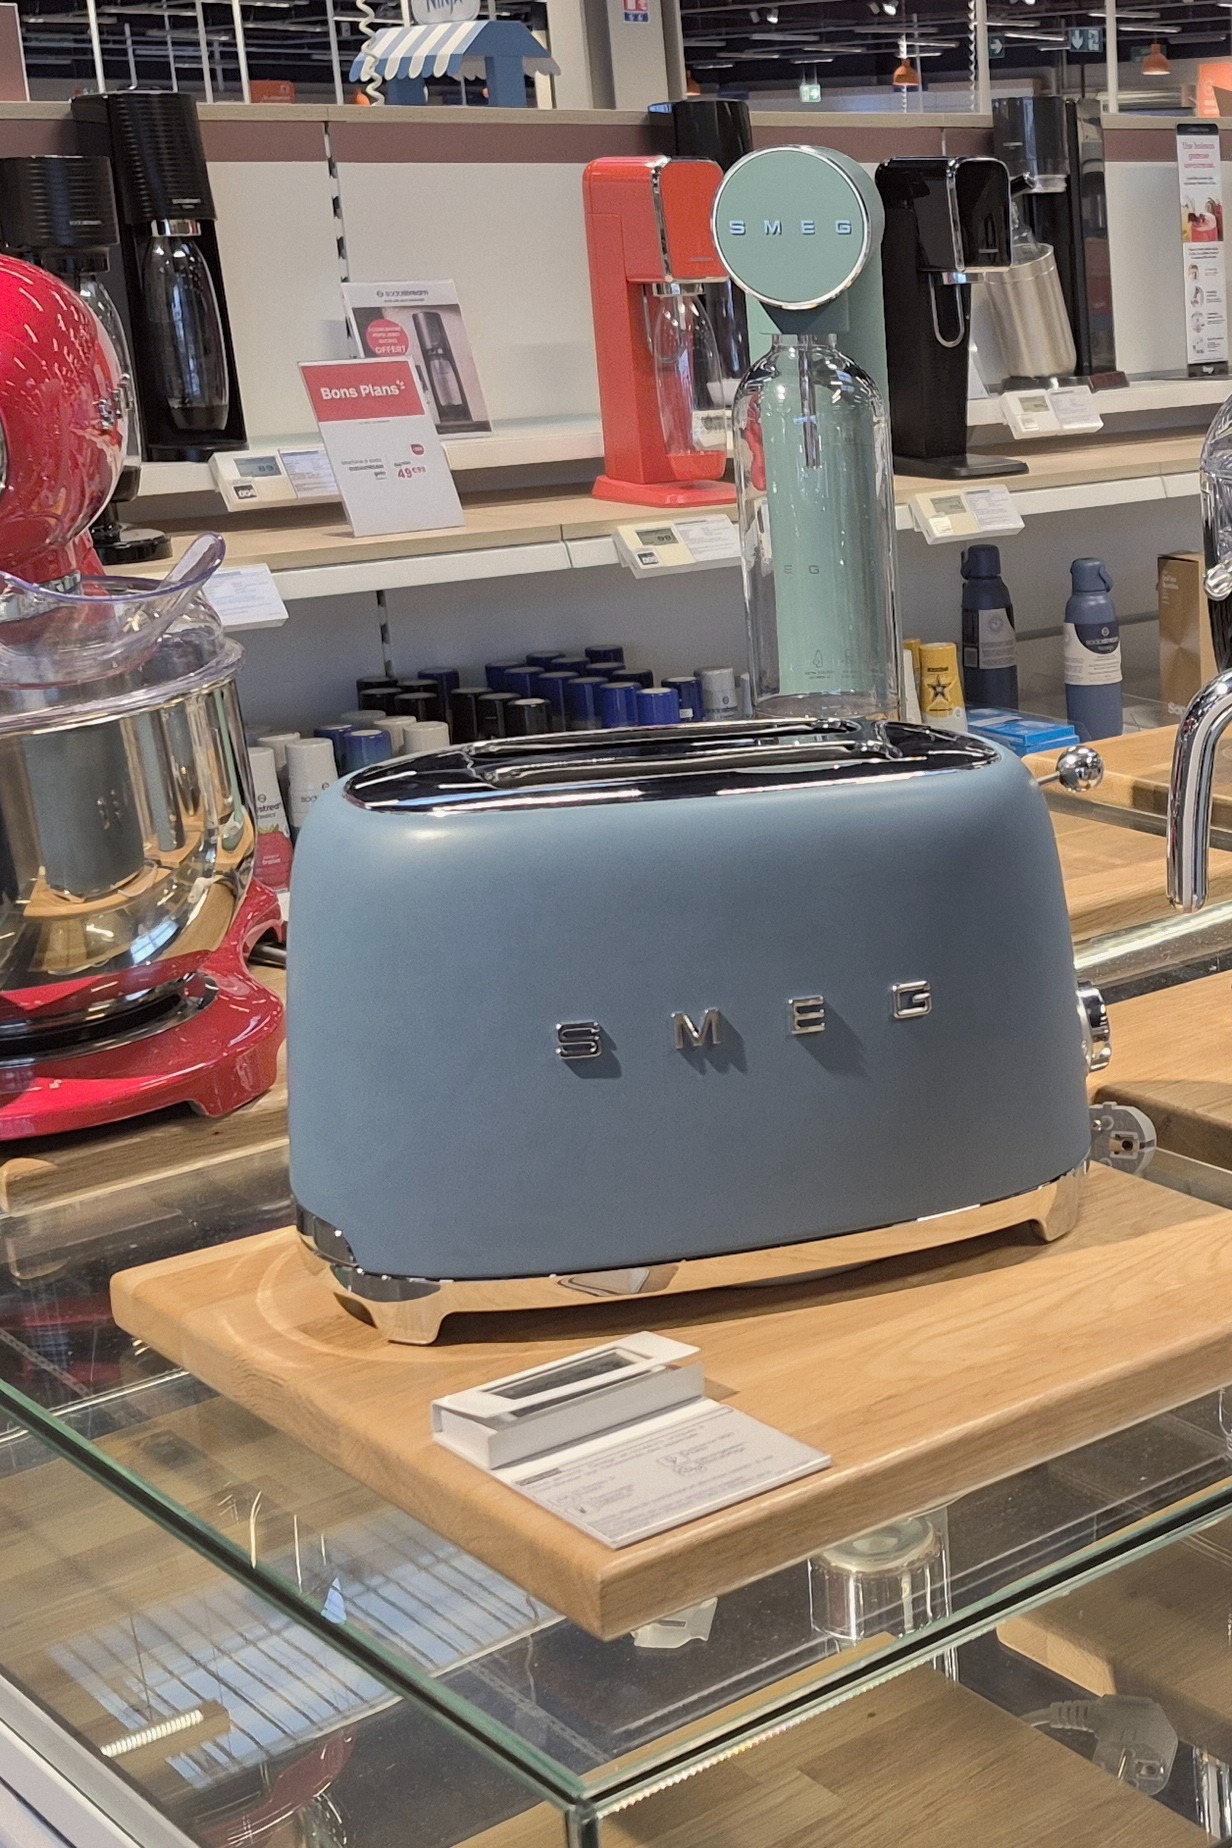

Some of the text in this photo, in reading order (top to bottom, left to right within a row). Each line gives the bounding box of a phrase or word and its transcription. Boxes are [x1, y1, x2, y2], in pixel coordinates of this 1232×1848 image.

[729, 219, 852, 236] SMEG
[320, 381, 400, 401] Bons Plans
[556, 980, 933, 1060] SMEG
